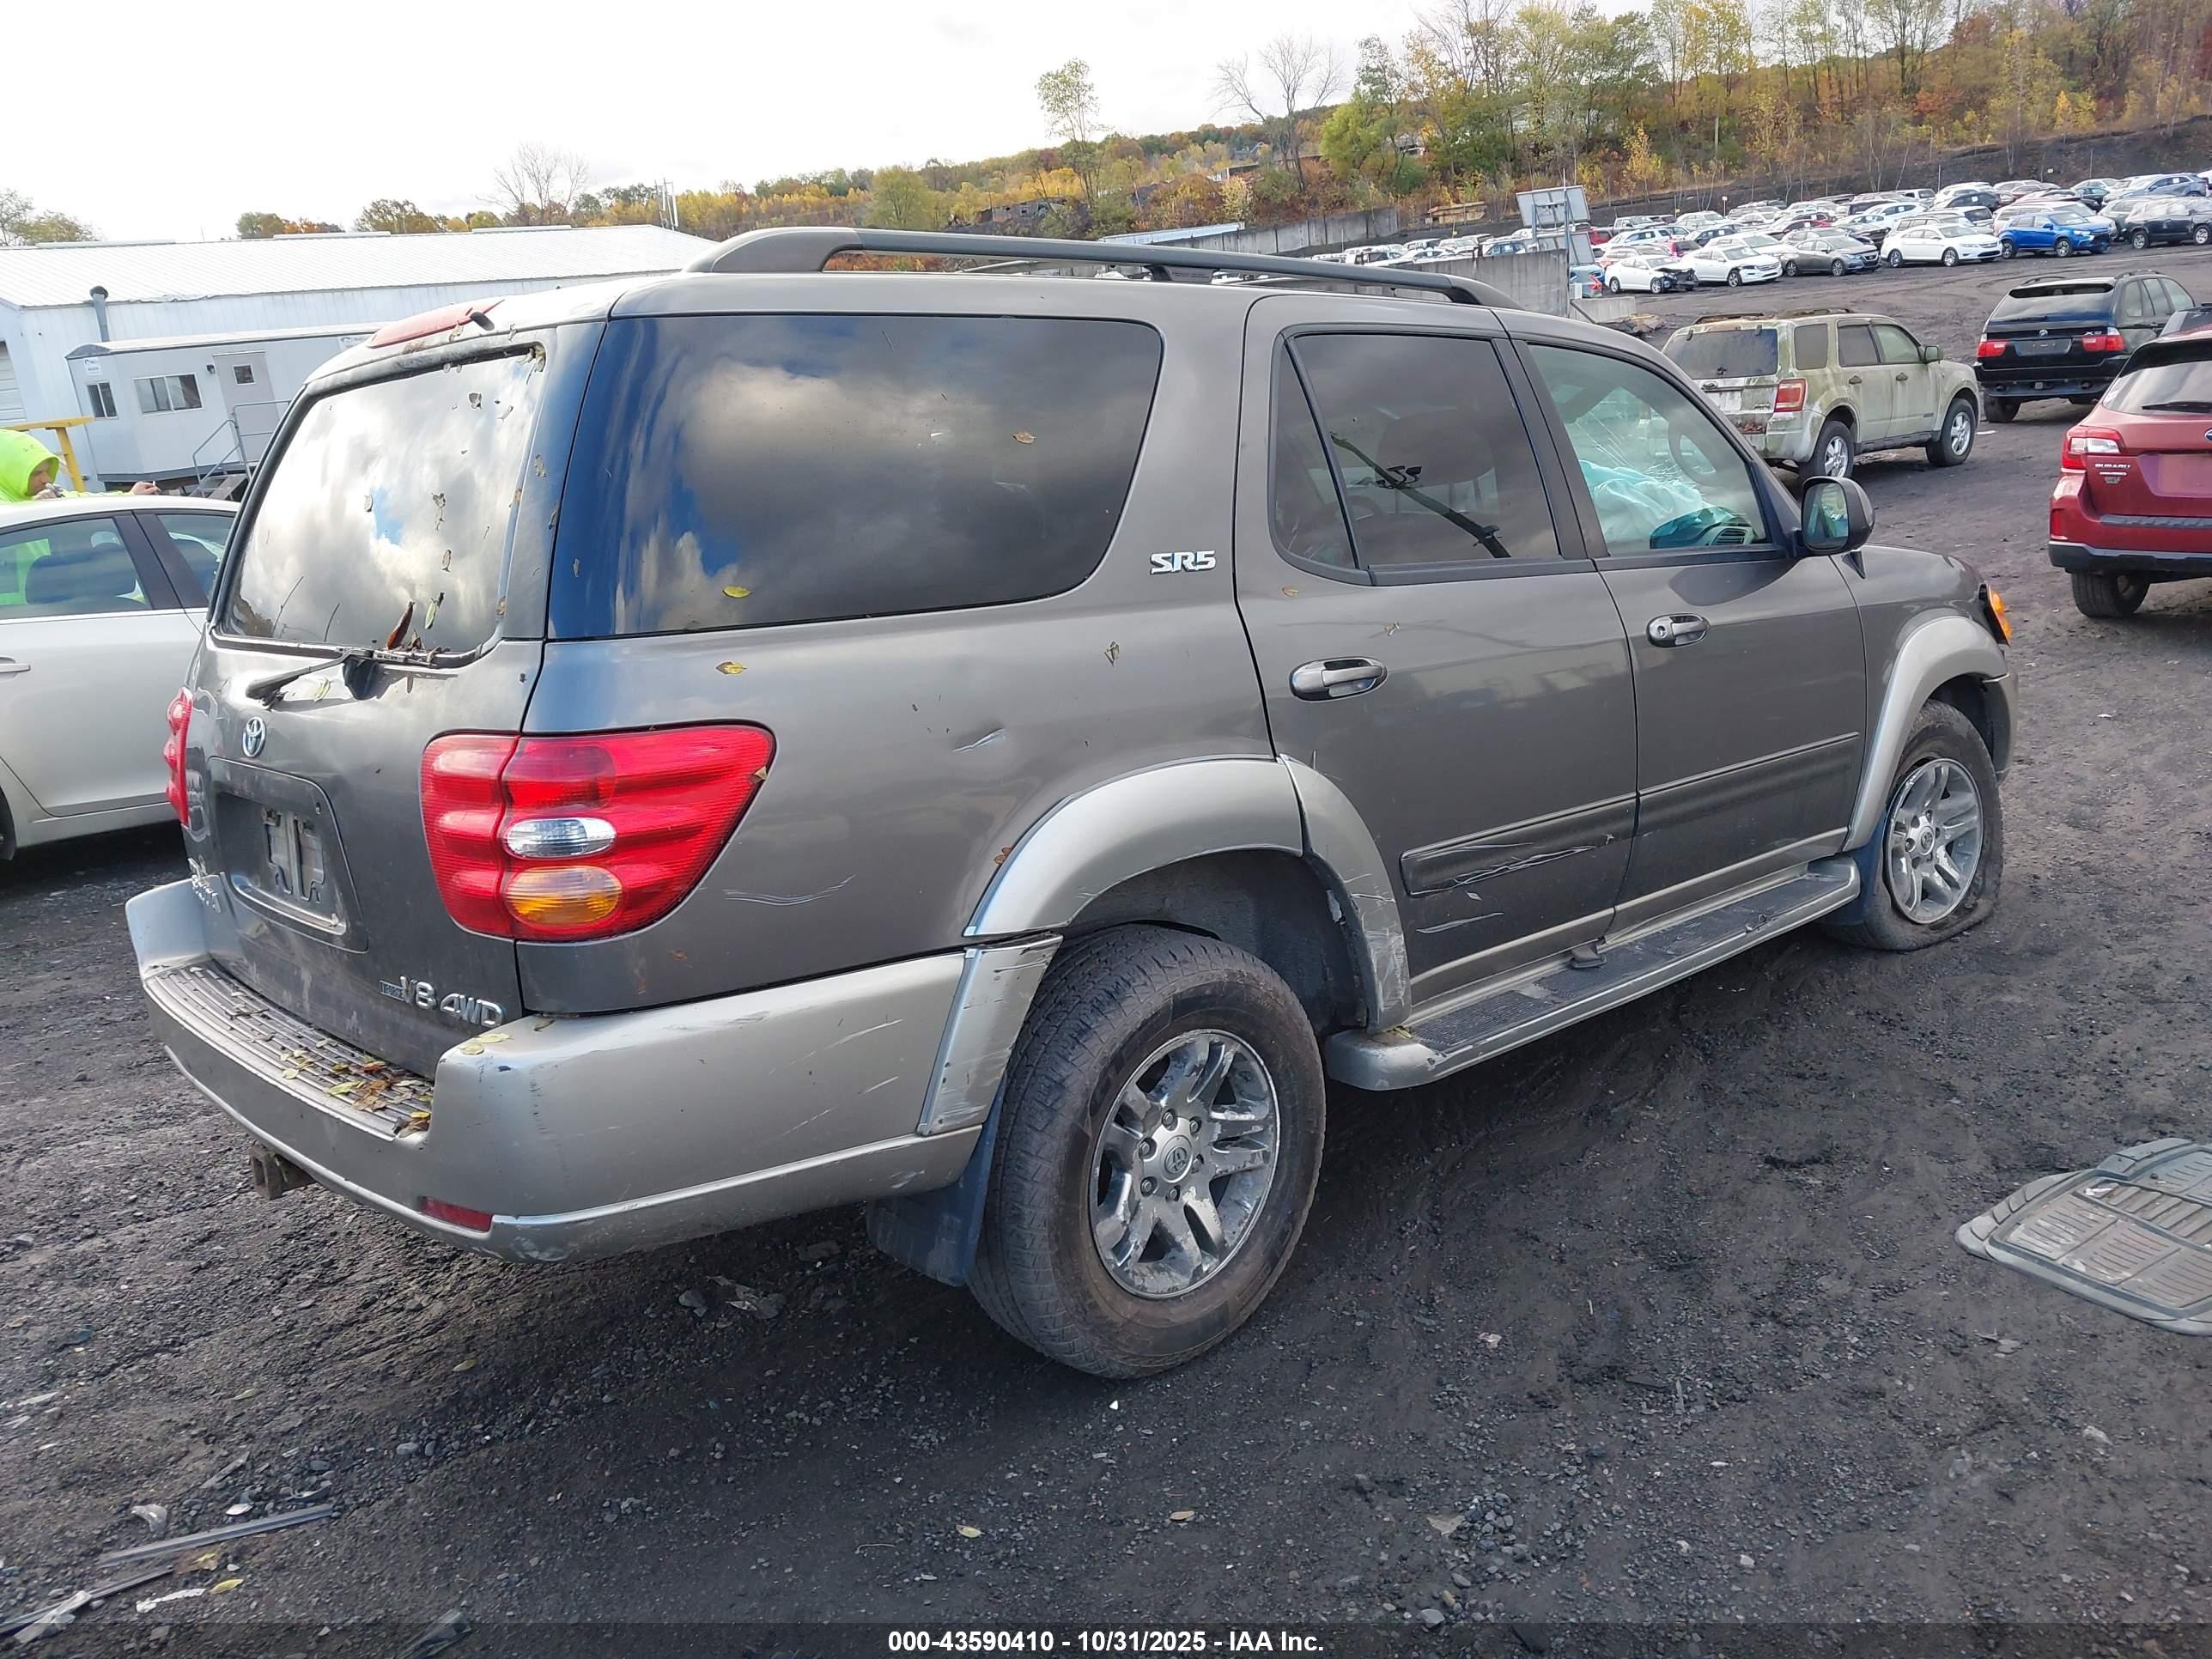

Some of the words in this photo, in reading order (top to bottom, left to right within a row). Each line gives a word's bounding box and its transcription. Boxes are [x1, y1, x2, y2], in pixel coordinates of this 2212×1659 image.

[1150, 550, 1217, 574] SR5
[399, 975, 437, 1010] V8
[440, 993, 503, 1029] 4WD
